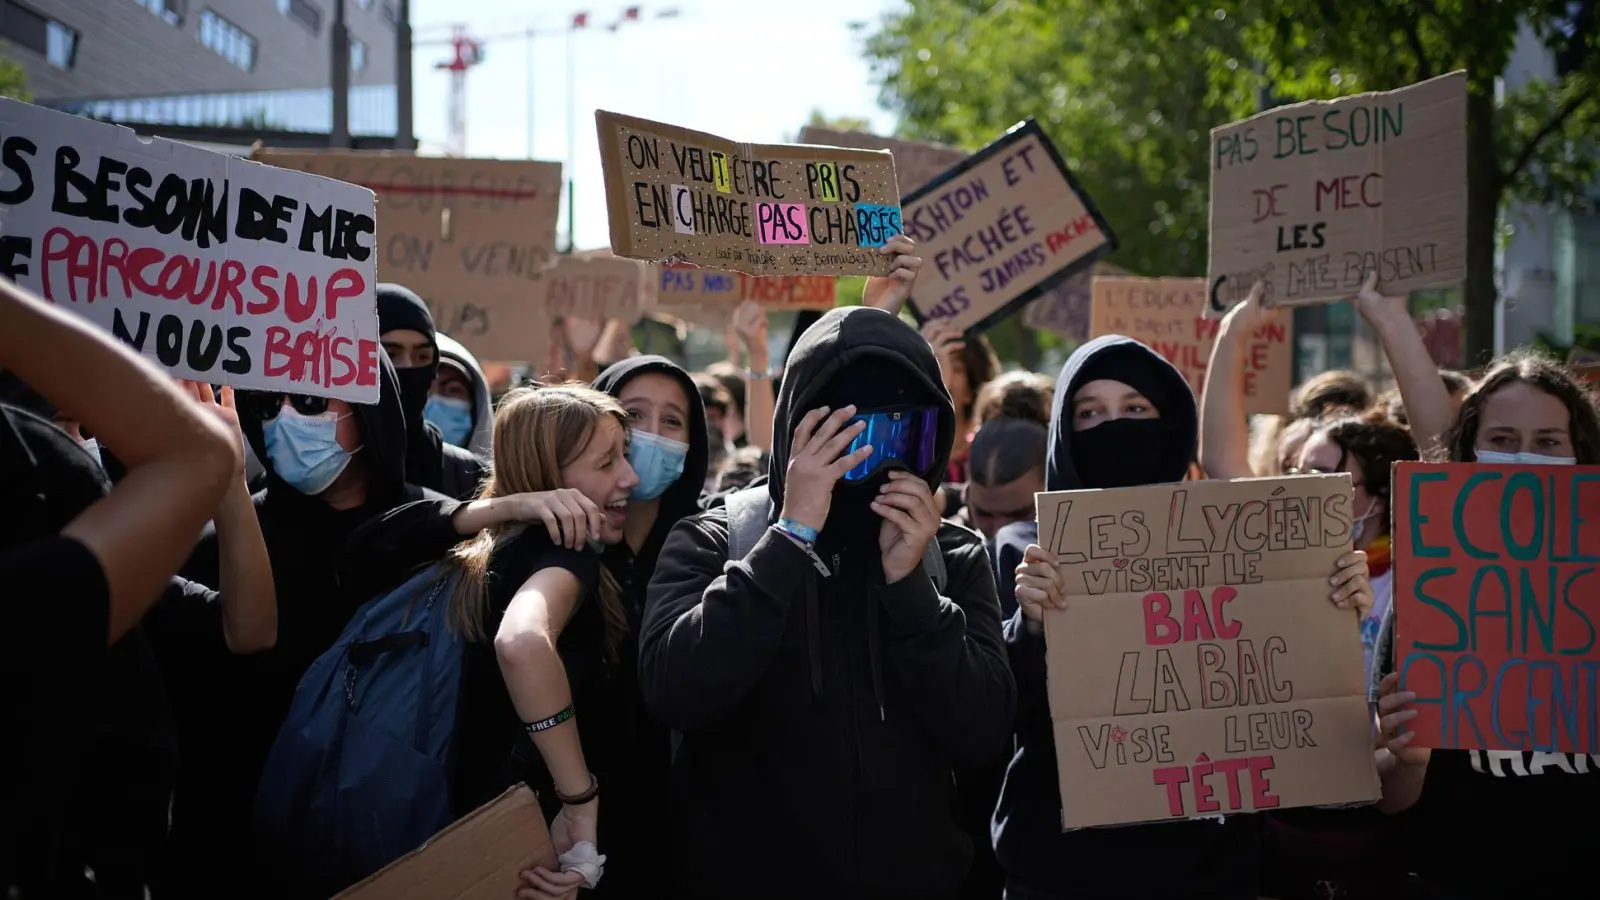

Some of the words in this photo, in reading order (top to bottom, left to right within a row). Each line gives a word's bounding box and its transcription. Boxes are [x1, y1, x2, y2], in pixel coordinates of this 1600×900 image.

[627, 134, 660, 170] ON
[671, 142, 727, 187] VEUT
[733, 154, 785, 200] ÊTRE
[805, 161, 861, 203] PRIS
[1215, 128, 1259, 170] PAS
[1273, 102, 1404, 159] BESOIN
[52, 146, 229, 249] BESOIN
[235, 187, 298, 244] DE
[298, 202, 375, 262] MEC
[634, 181, 669, 229] EN
[677, 187, 753, 238] CHARGE
[758, 203, 802, 243] PAS
[810, 206, 901, 247] CHARGÉS
[903, 176, 991, 243] ASHION
[1001, 144, 1036, 187] ET
[1252, 183, 1288, 224] DE
[1315, 172, 1384, 213] MEC
[933, 204, 1035, 281] FACHÉE
[1276, 222, 1327, 254] LES
[1343, 243, 1438, 291] BAISENT
[41, 226, 366, 324] PARCOURSUP
[923, 284, 970, 322] AIS
[978, 241, 1048, 293] JAMAIS
[112, 307, 252, 375] NOUS
[1049, 500, 1151, 565] LES
[1409, 472, 1600, 563] ECOLE
[1223, 552, 1264, 586] LE
[1142, 586, 1243, 646] BAC
[1413, 564, 1596, 655] SANS
[1113, 648, 1191, 716] LA
[1197, 636, 1293, 709] BAC
[1399, 652, 1600, 754] ARGENT
[531, 717, 557, 732] FREE
[1224, 710, 1317, 753] LEUR
[1153, 752, 1280, 816] TÊTE
